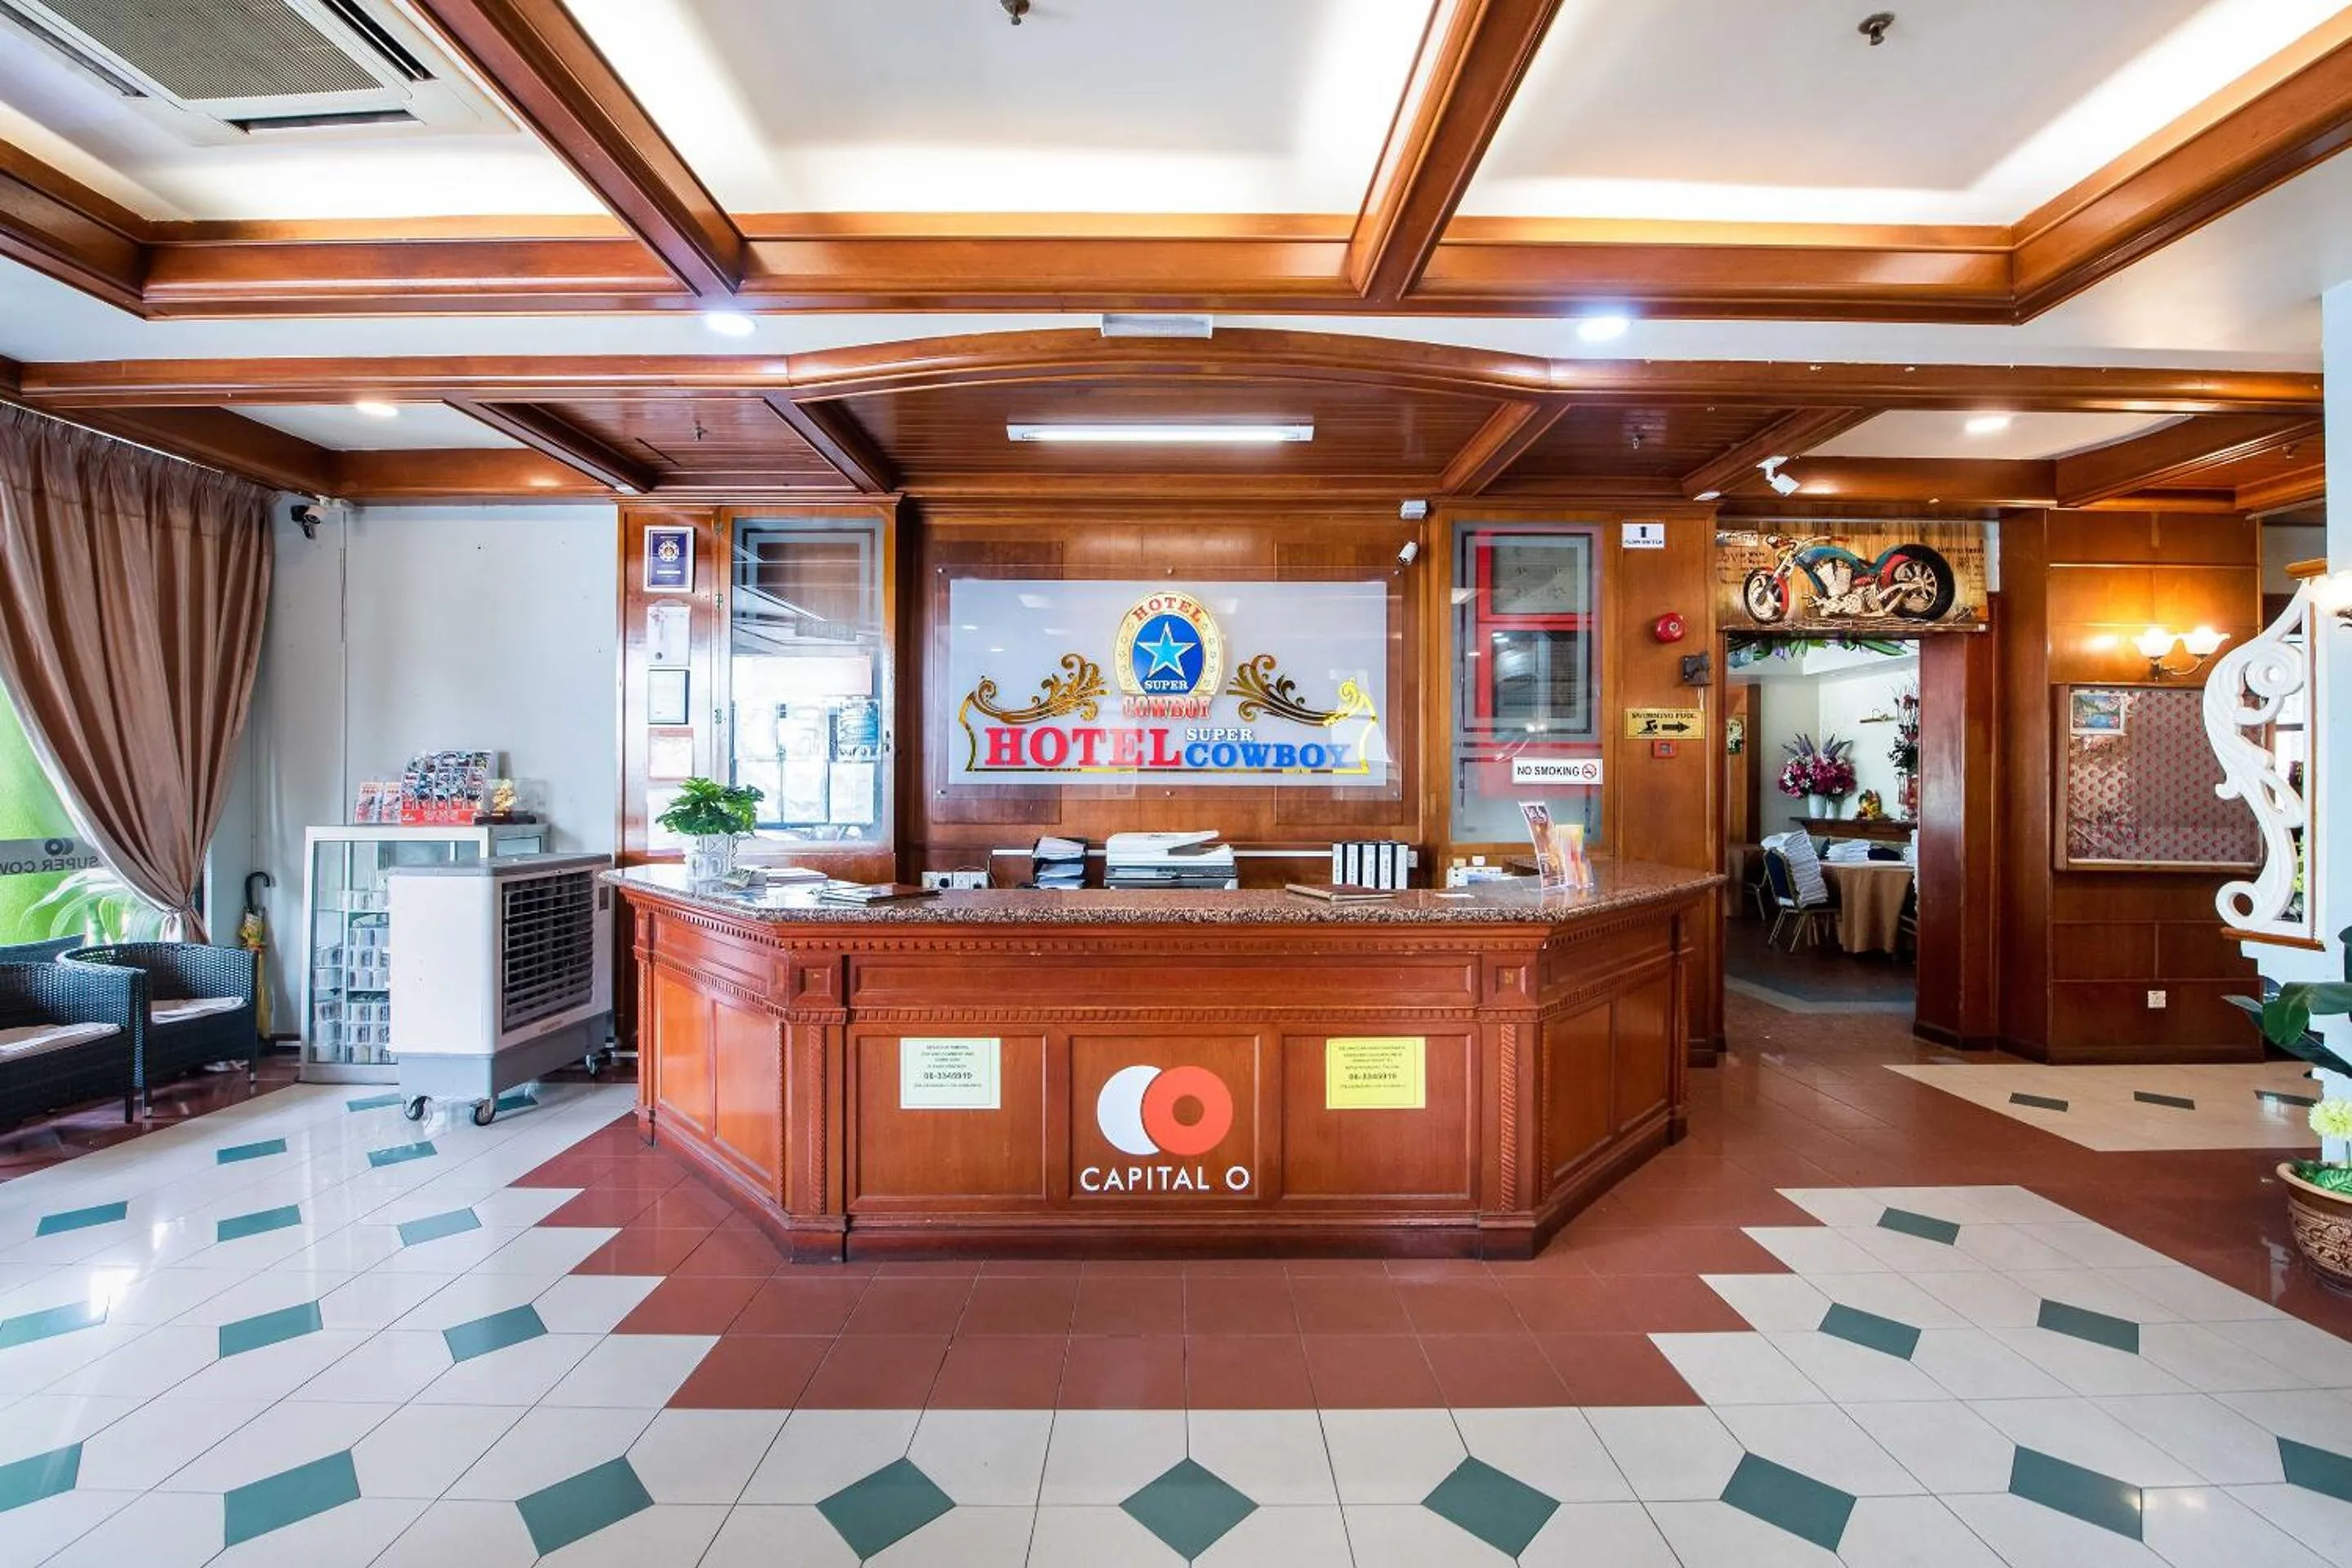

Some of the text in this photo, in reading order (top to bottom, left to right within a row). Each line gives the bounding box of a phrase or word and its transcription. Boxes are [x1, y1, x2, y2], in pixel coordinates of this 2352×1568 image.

[1132, 597, 1201, 622] HOTEL
[1144, 679, 1189, 691] SUPER
[1121, 696, 1213, 720] COWBOY
[984, 726, 1182, 767] HOTEL
[1186, 728, 1255, 742] SUPER
[1184, 742, 1352, 768] COWBOY
[1517, 765, 1580, 777] NO SMOKING
[1080, 1165, 1250, 1192] CAPITAL O
